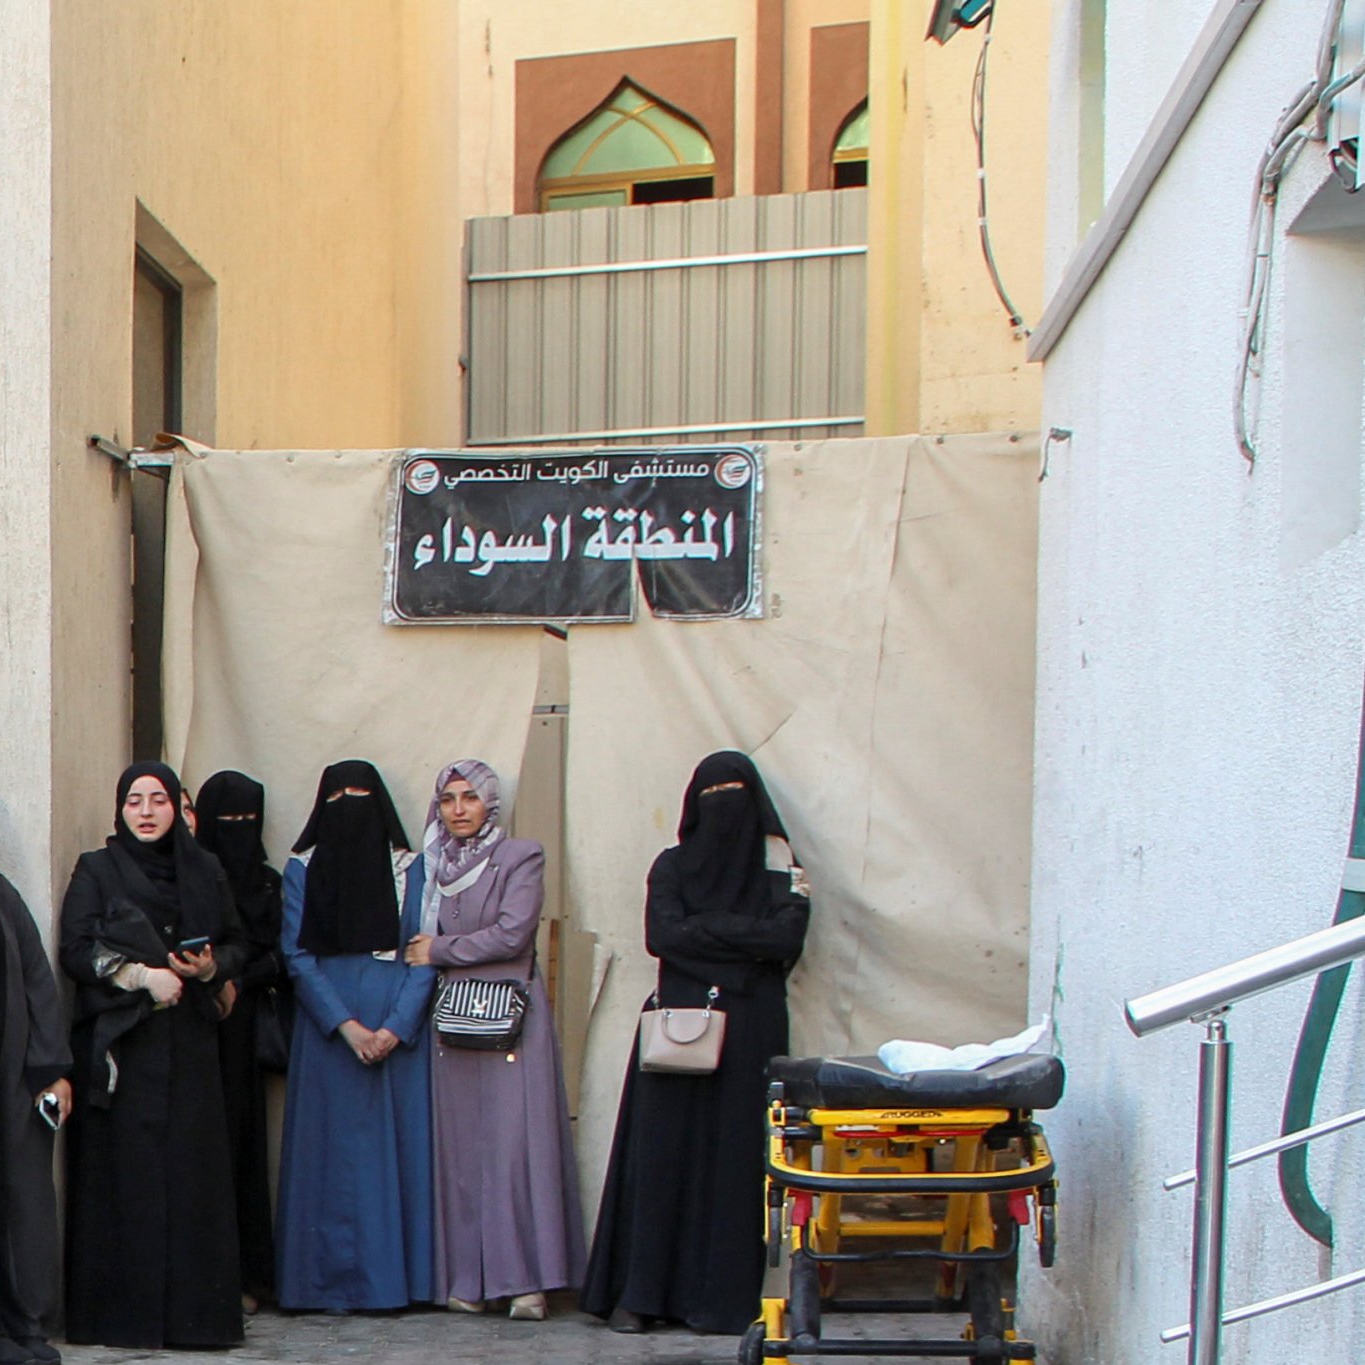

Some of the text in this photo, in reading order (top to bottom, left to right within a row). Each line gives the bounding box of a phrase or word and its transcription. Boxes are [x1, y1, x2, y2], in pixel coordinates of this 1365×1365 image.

[444, 457, 710, 489] مستشفى الكويت التخصصي
[414, 505, 734, 576] المنطقة السوداء
